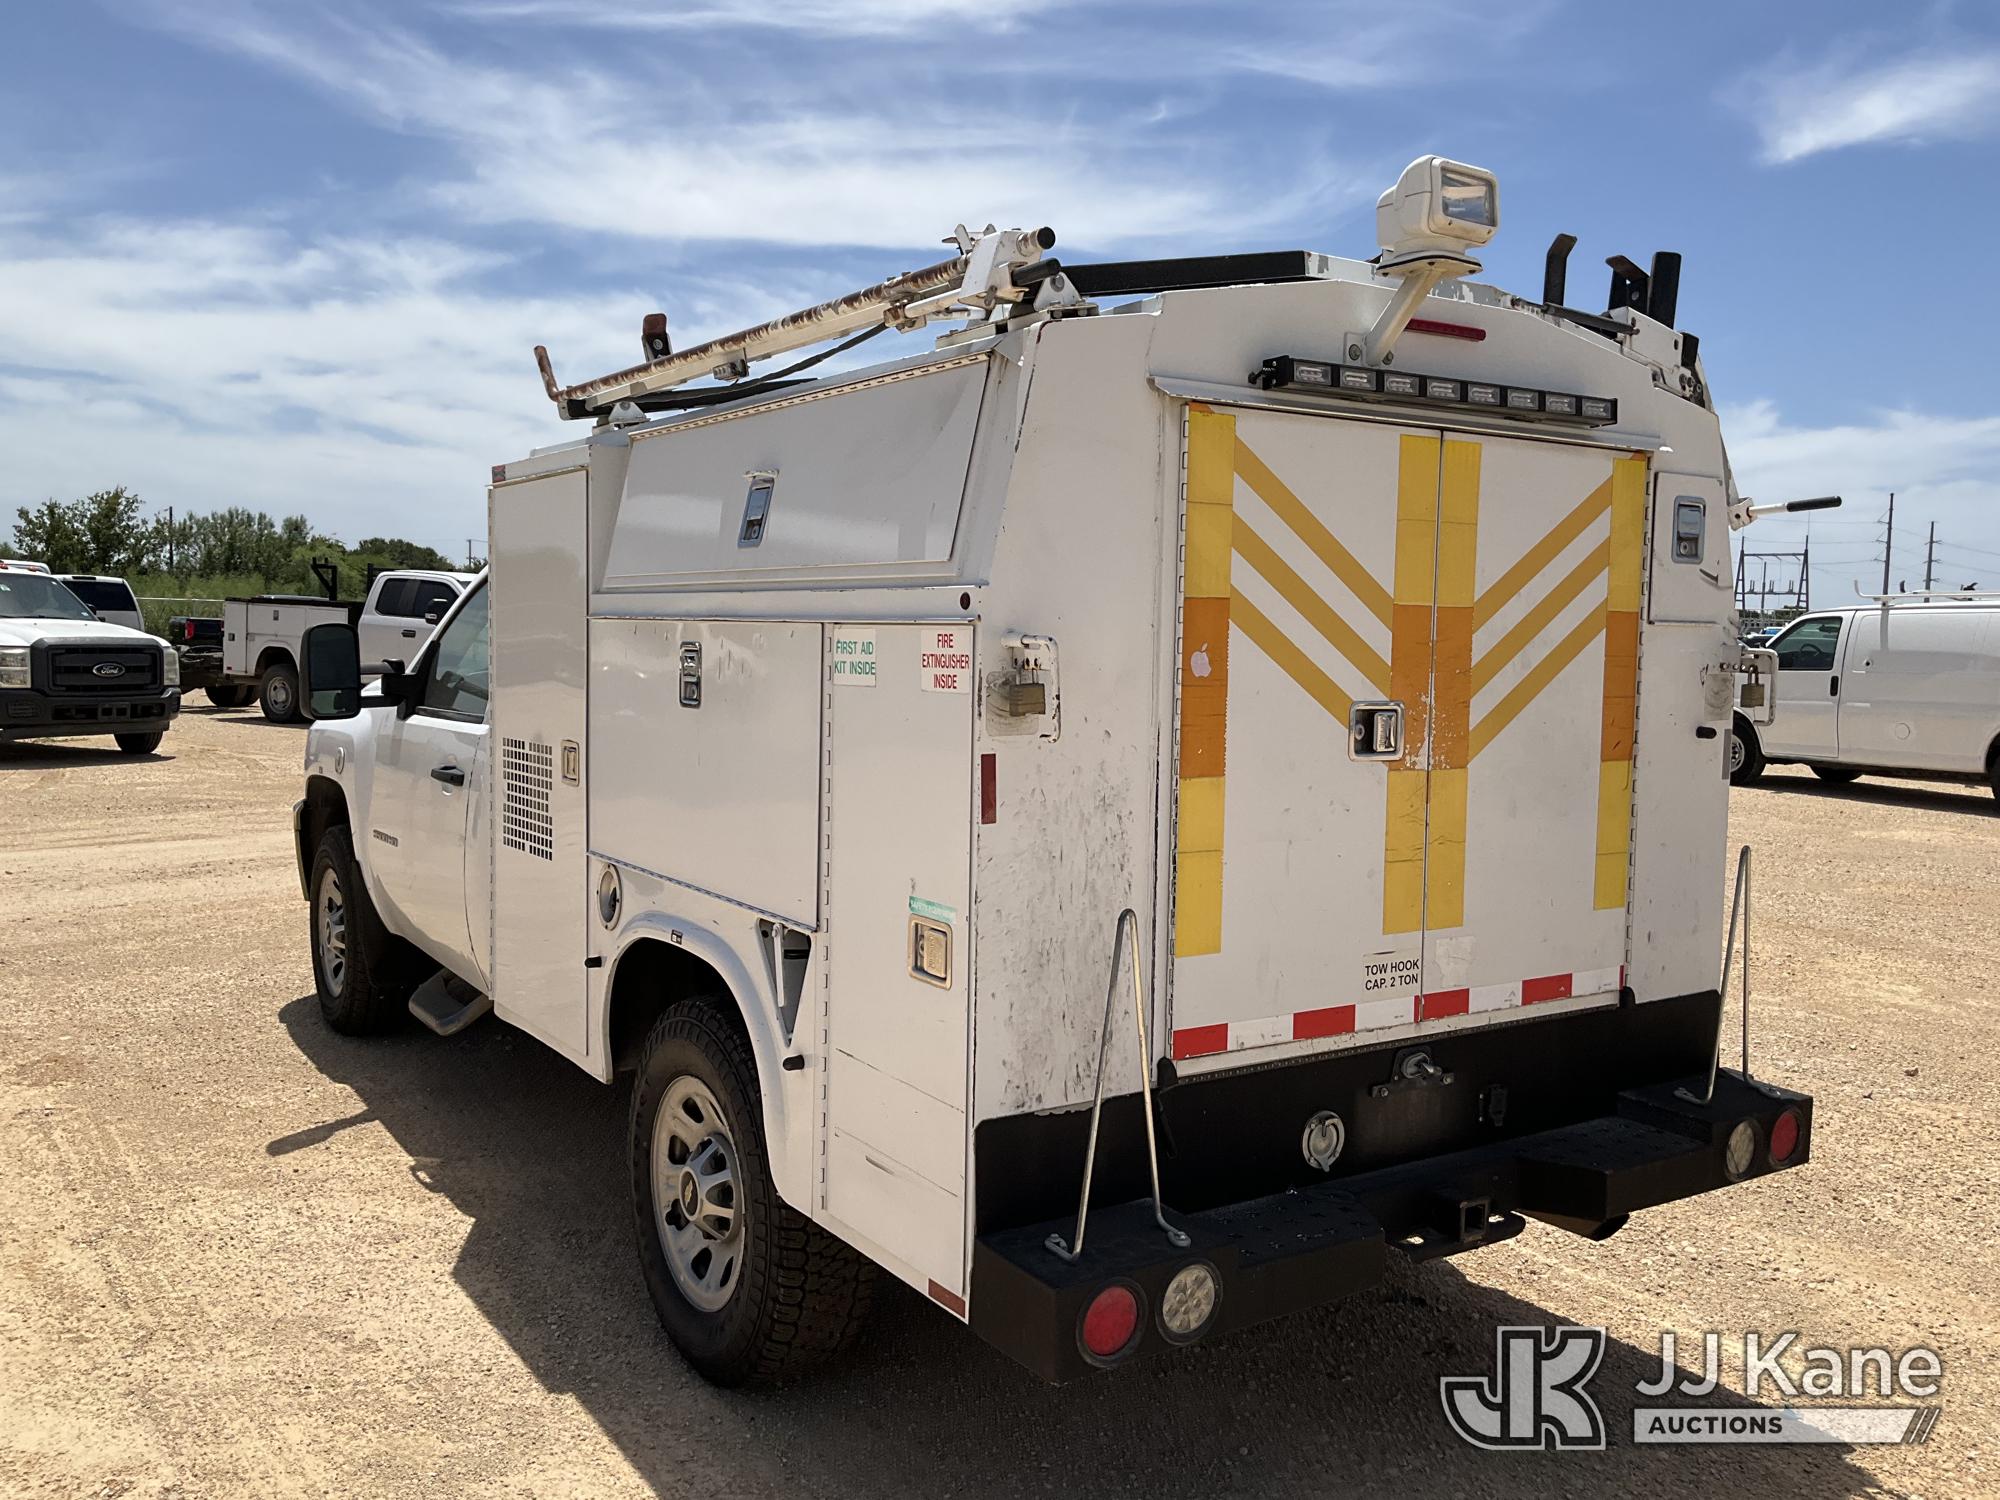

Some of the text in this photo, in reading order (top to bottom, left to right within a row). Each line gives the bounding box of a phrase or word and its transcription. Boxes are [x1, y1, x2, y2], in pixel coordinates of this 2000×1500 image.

[835, 639, 874, 656] FIRST AID
[937, 633, 954, 649] FIRE
[834, 660, 876, 675] KIT INSIDE
[922, 653, 970, 669] EXTINGUISHER
[933, 674, 958, 690] INSIDE
[1365, 958, 1420, 977] TOW HOOK
[1365, 973, 1419, 991] CAP. 2 TON
